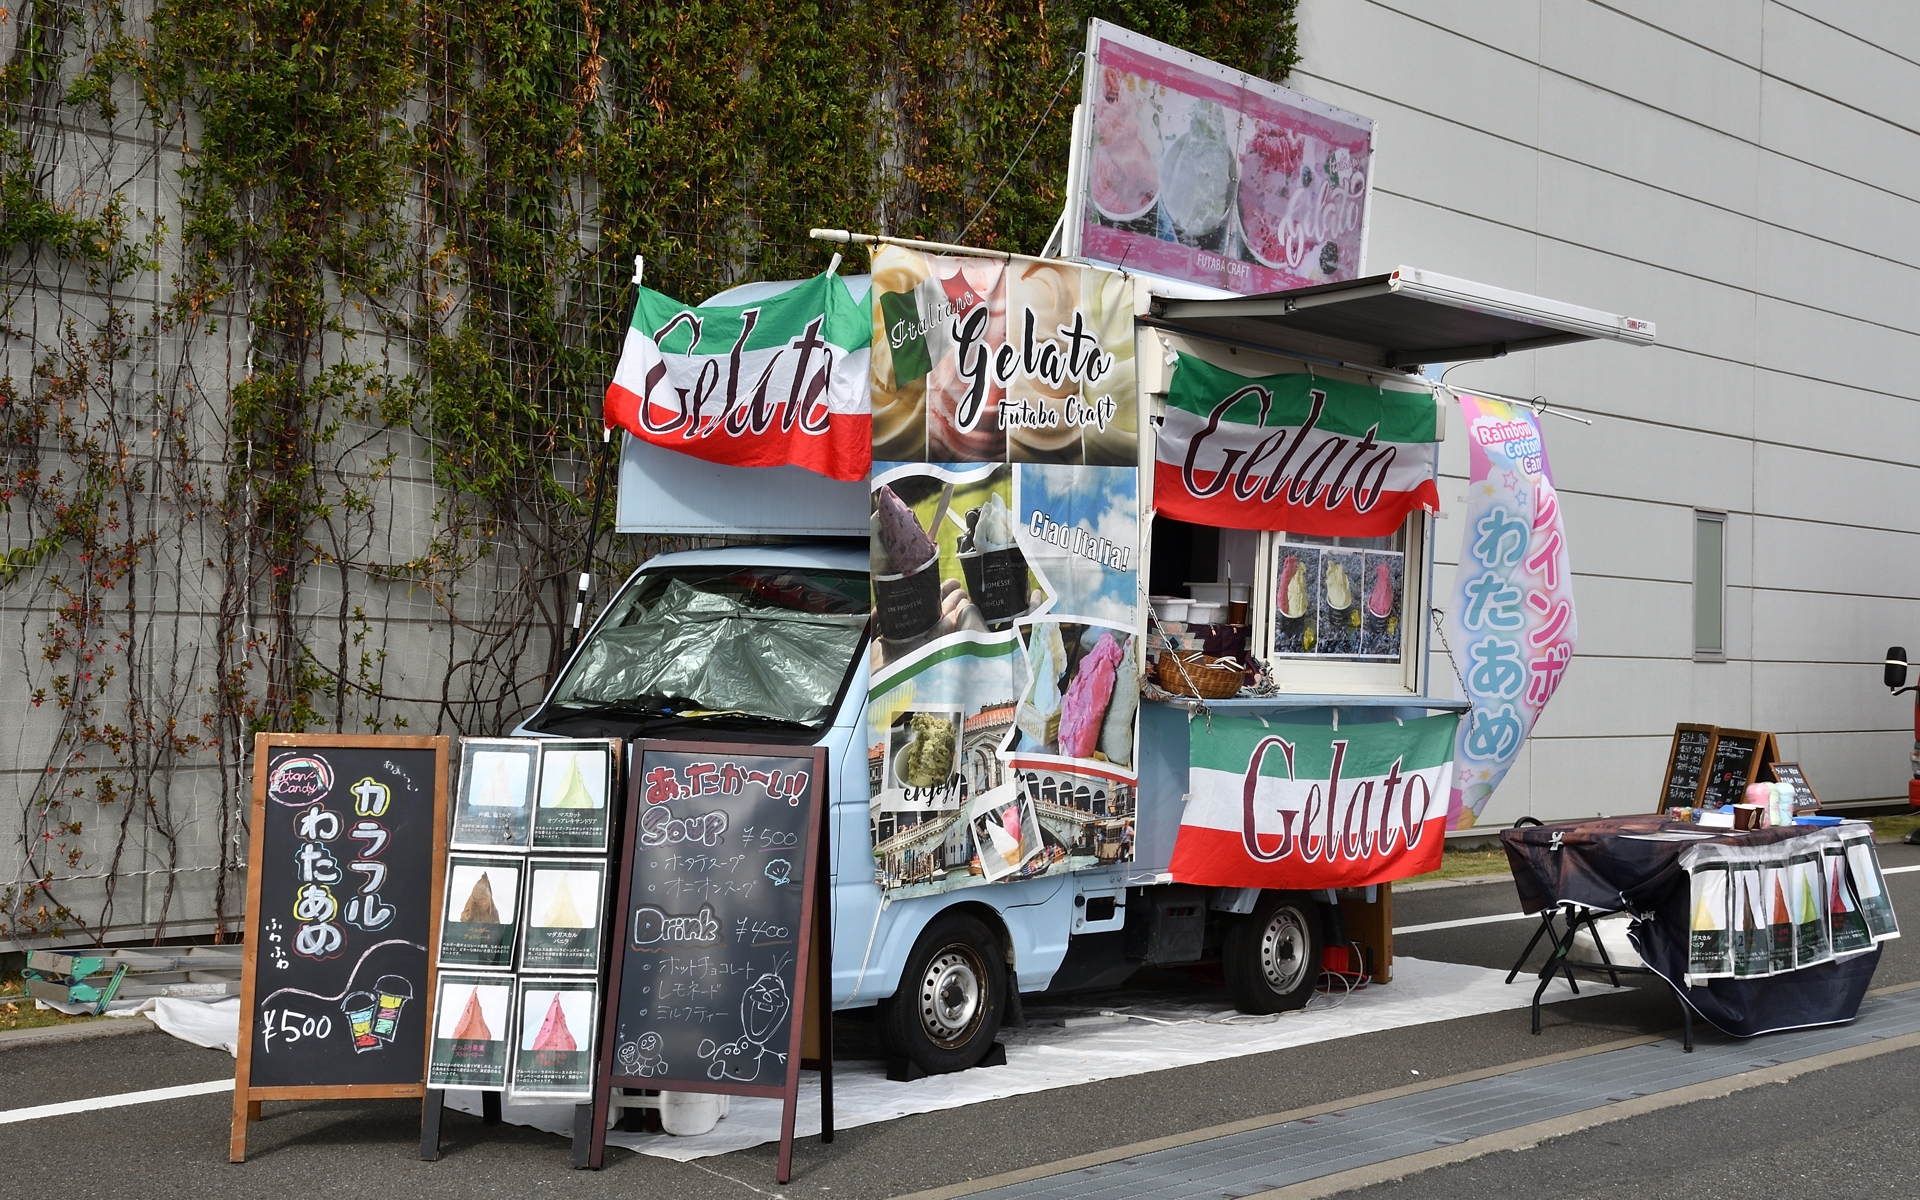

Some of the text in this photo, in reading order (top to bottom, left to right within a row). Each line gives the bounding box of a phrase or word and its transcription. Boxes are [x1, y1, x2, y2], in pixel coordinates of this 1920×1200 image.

[1196, 253, 1250, 278] FUTABA CRAFT
[890, 290, 974, 350] Italiano
[639, 307, 833, 440] Gelato
[951, 303, 1113, 433] Gelato
[998, 394, 1117, 433] Futaba Craft
[1477, 421, 1533, 445] Rainbow
[1182, 384, 1397, 514] Gelato
[1504, 438, 1541, 460] Cotton
[1029, 509, 1131, 572] Ciao Italia!
[1464, 503, 1531, 764] わたあめ
[278, 781, 318, 797] Candy
[903, 773, 960, 808] enjoy!
[1242, 734, 1431, 863] Gelato
[742, 826, 798, 848] ¥500
[346, 779, 392, 928] カラフル
[664, 854, 746, 873] ホタテスープ
[296, 806, 342, 958] わたあめ
[664, 877, 758, 901] オニオンスープ
[633, 906, 720, 945] Drink
[735, 917, 790, 943] ¥400
[1738, 935, 1745, 947] 2
[265, 917, 290, 970] ふわふわ
[658, 955, 756, 982] ホットチョコレート
[658, 981, 723, 1001] レモネード
[656, 1004, 729, 1024] ミルクティー
[261, 1007, 333, 1053] ¥500
[451, 1044, 485, 1052] たっぷり果実
[455, 1051, 484, 1059] ストロベリー
